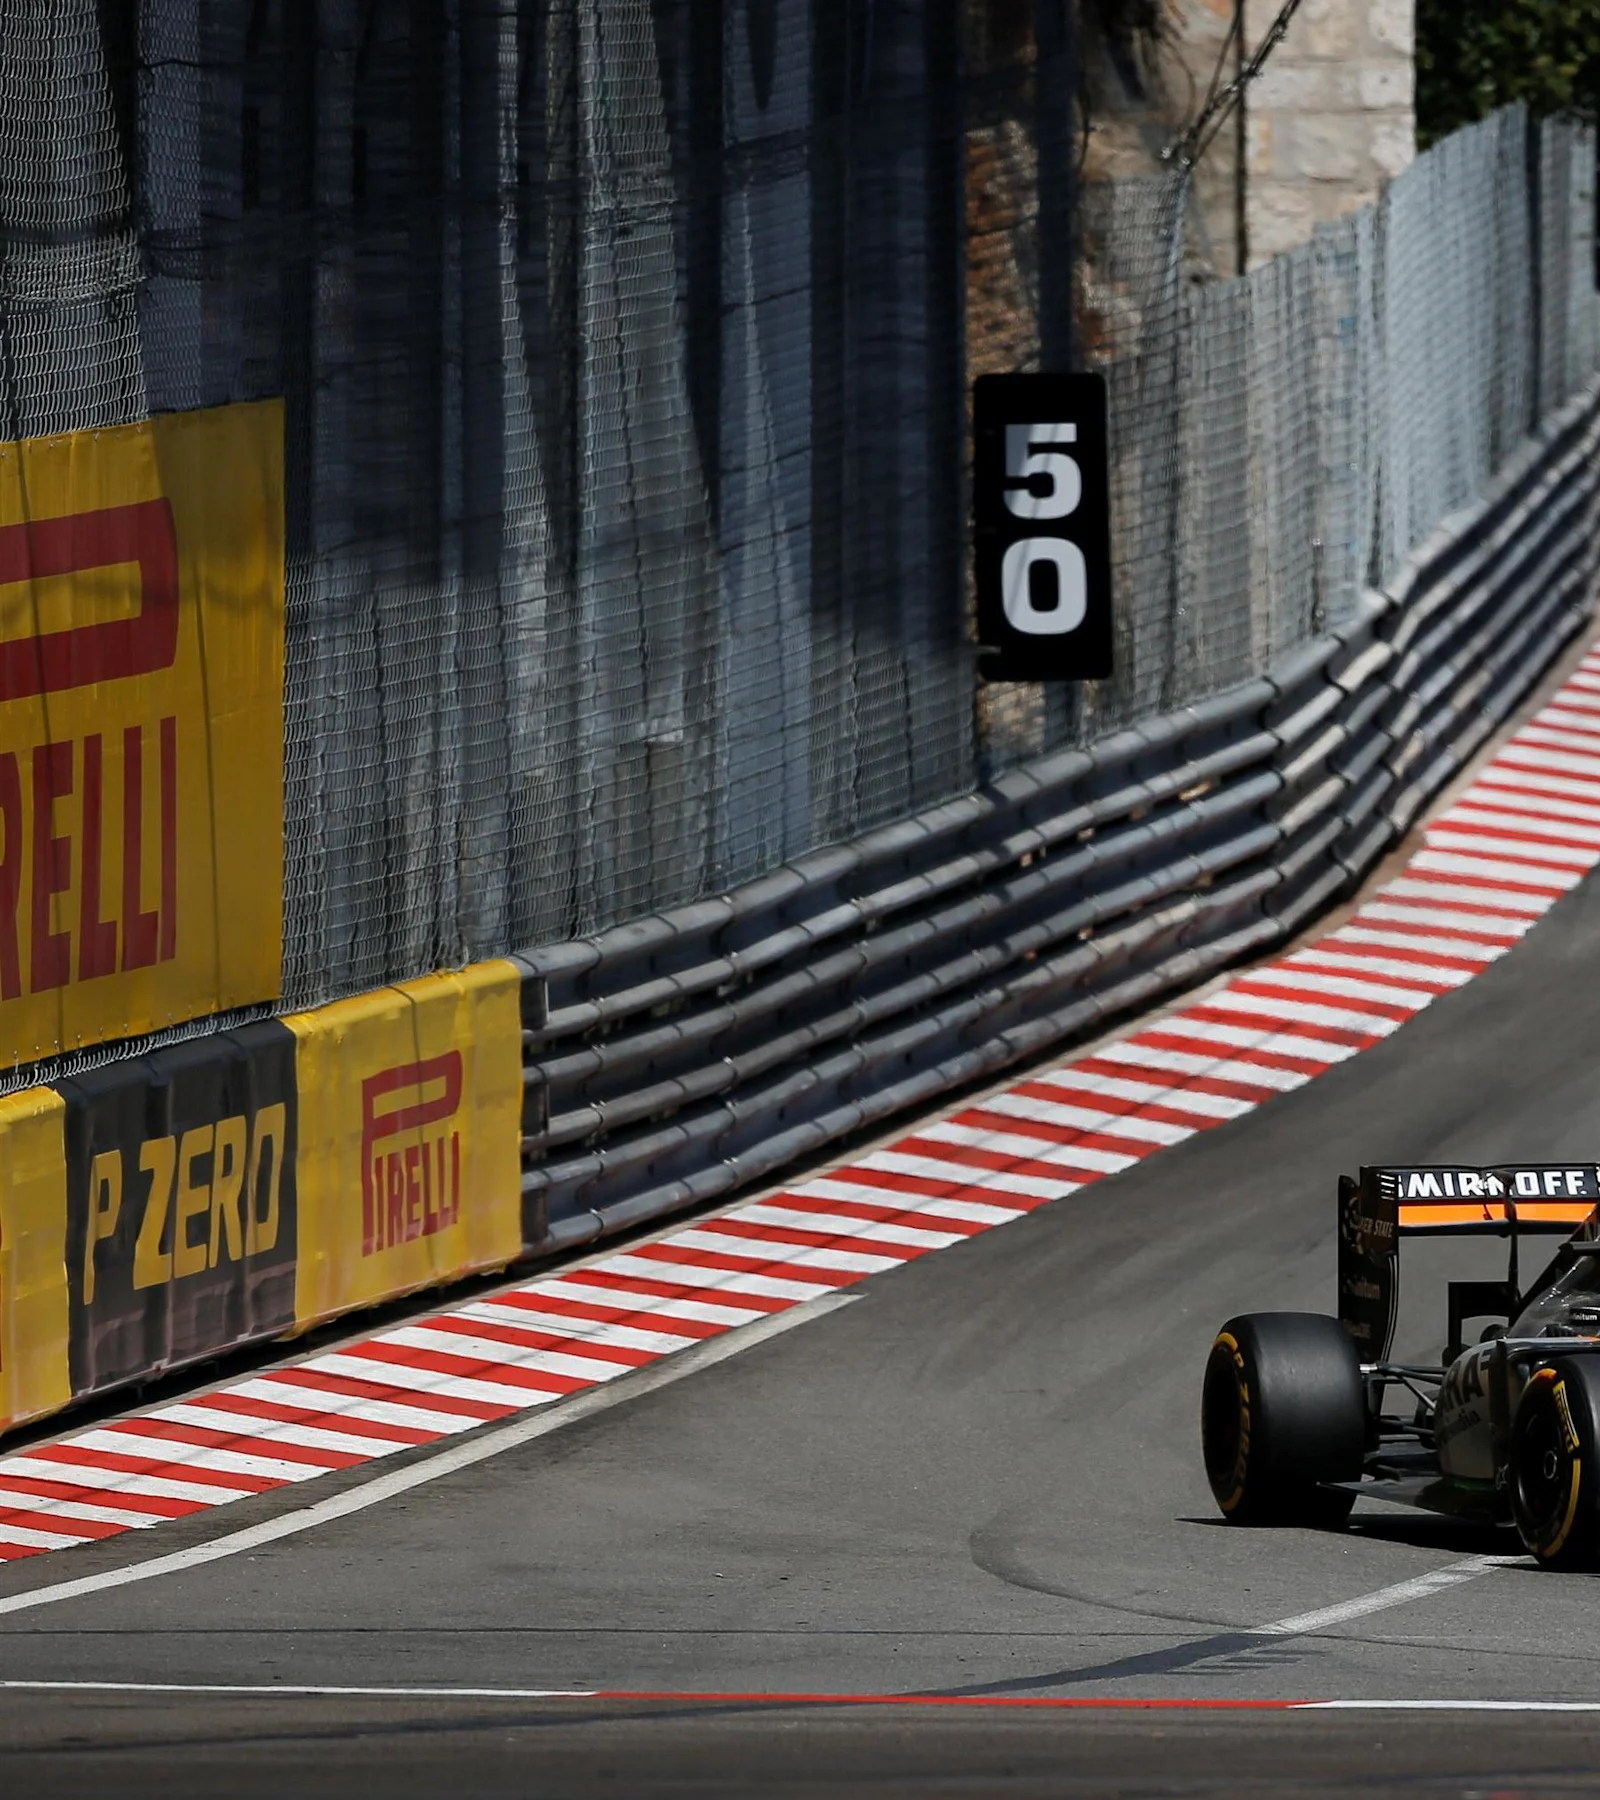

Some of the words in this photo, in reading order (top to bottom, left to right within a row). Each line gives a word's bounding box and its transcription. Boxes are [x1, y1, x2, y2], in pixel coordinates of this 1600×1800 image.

[1001, 423, 1088, 635] 50
[83, 1149, 122, 1306] P
[133, 1103, 287, 1290] ZERO
[361, 1050, 464, 1257] PIRELLI
